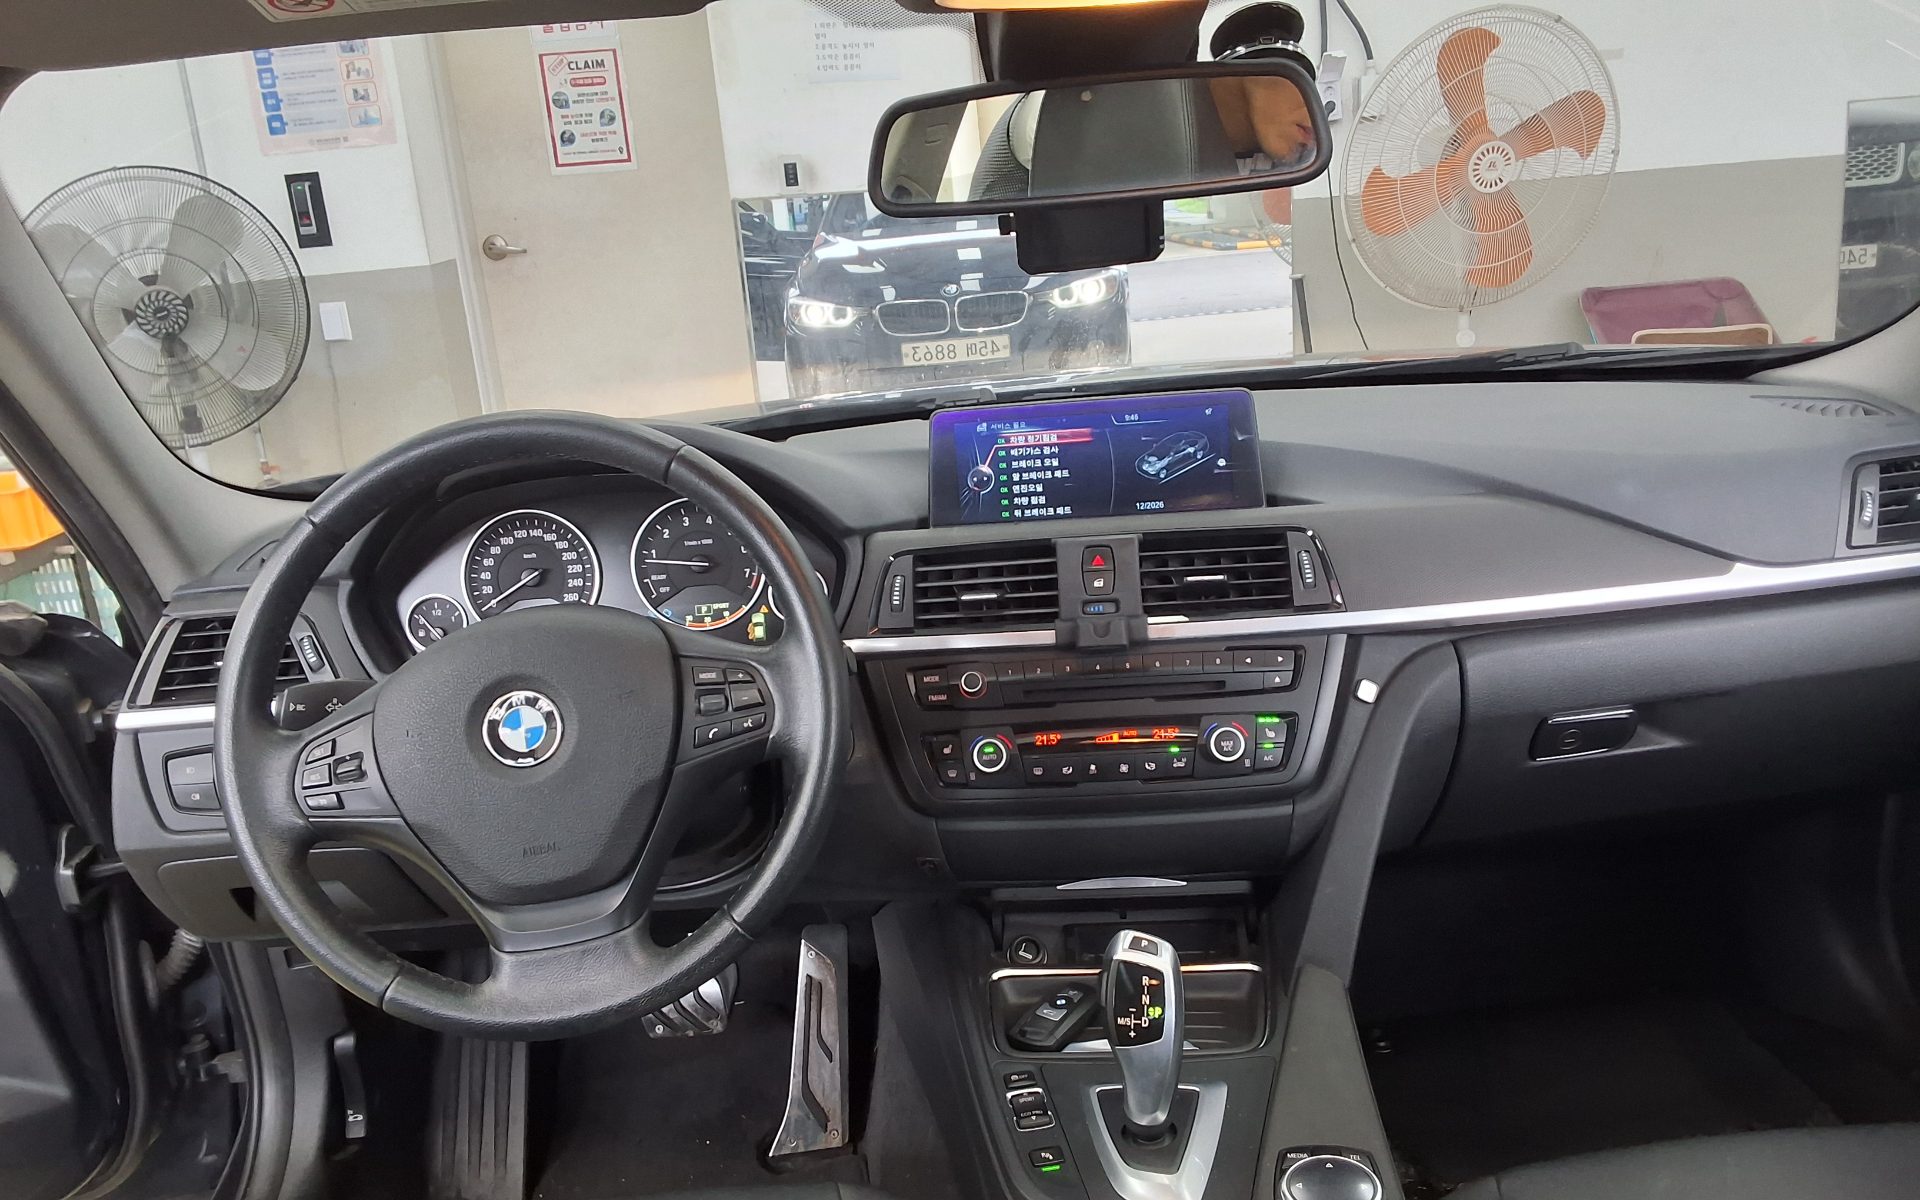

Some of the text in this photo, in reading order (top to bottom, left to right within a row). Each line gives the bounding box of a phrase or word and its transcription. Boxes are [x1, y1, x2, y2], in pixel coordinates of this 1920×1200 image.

[567, 58, 606, 71] CLAIM
[990, 422, 1011, 430] 서비스
[1009, 436, 1026, 444] 차량
[1010, 447, 1042, 456] 배기가스
[1043, 445, 1059, 454] 검사
[1011, 459, 1042, 468] 브레이크
[1044, 457, 1059, 467] 오일
[1022, 470, 1053, 480] 브레이크
[1054, 469, 1070, 478] 패드
[1012, 483, 1043, 493] 엔진오일
[1013, 496, 1029, 505] 차량
[1136, 501, 1165, 510] 12/2026
[1014, 509, 1022, 517] 뒤
[1024, 507, 1055, 517] 브레이크
[1056, 506, 1072, 515] 패드
[682, 517, 689, 526] 3
[705, 515, 713, 525] 4
[513, 529, 527, 538] 120
[528, 528, 543, 537] 140
[543, 533, 557, 541] 160
[662, 529, 669, 538] 2
[500, 536, 514, 545] 100
[490, 546, 501, 554] 80
[555, 541, 569, 550] 180
[561, 552, 577, 560] 200
[651, 549, 656, 558] 1
[483, 558, 494, 566] 60
[567, 565, 582, 573] 220
[744, 568, 751, 578] 7
[480, 572, 491, 580] 40
[567, 578, 583, 587] 240
[481, 586, 493, 594] 20
[563, 593, 579, 602] 260
[923, 675, 940, 683] MODE
[1141, 939, 1149, 948] P
[1142, 975, 1149, 986] R
[1142, 994, 1150, 1005] N
[1117, 1016, 1149, 1027] M/S D
